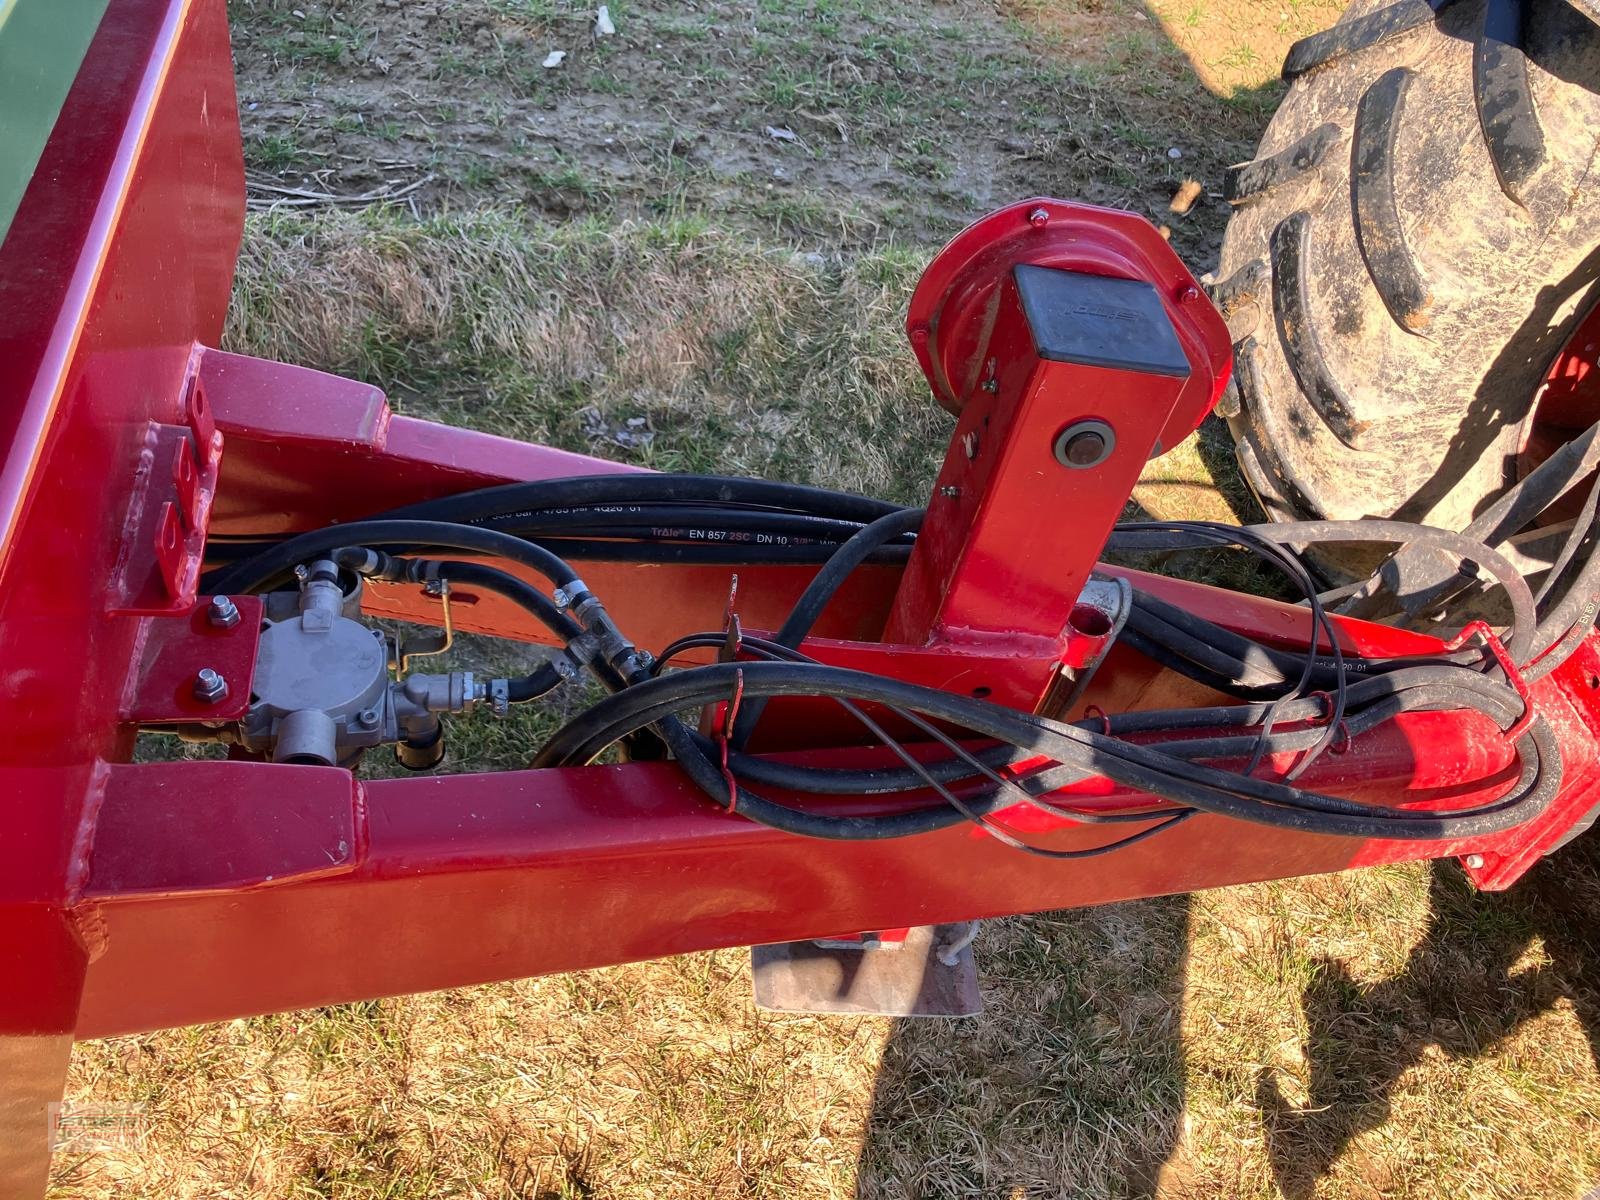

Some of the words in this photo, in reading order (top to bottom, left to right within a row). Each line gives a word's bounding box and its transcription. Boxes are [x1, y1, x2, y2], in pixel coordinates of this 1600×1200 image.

[689, 529, 705, 539] EN
[707, 530, 726, 540] 857
[729, 531, 751, 541] 2SC
[756, 534, 773, 544] DN
